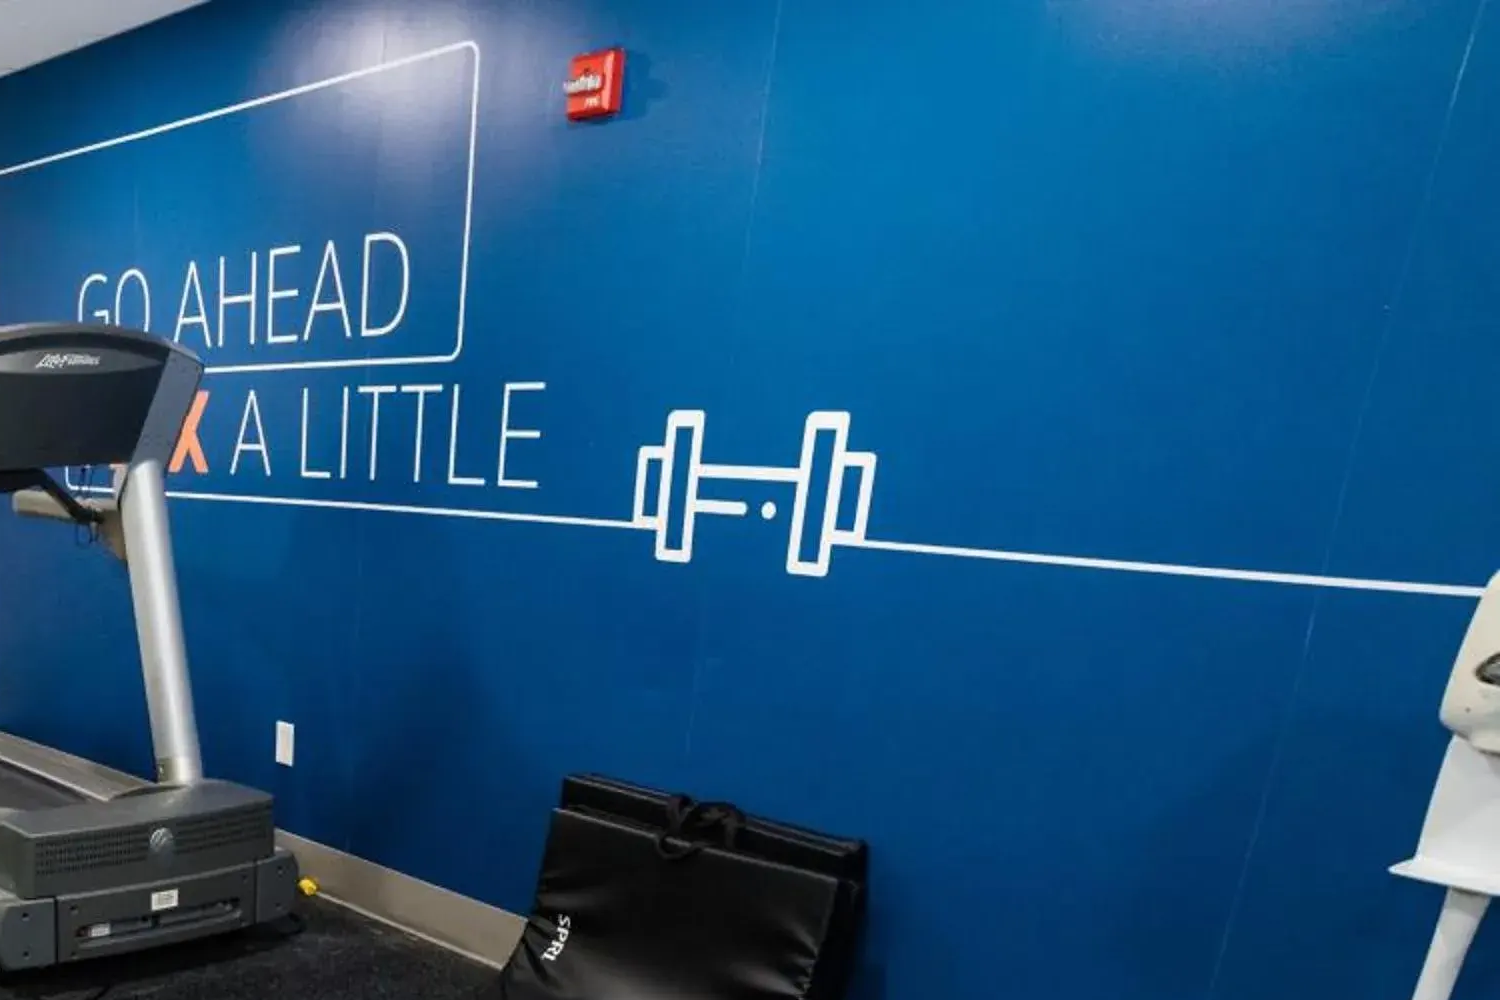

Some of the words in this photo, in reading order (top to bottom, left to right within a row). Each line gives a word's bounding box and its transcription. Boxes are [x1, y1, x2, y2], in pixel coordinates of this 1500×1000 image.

[77, 268, 150, 333] GO
[173, 231, 410, 348] AHEAD
[230, 388, 272, 477] A
[300, 381, 546, 489] LITTLE
